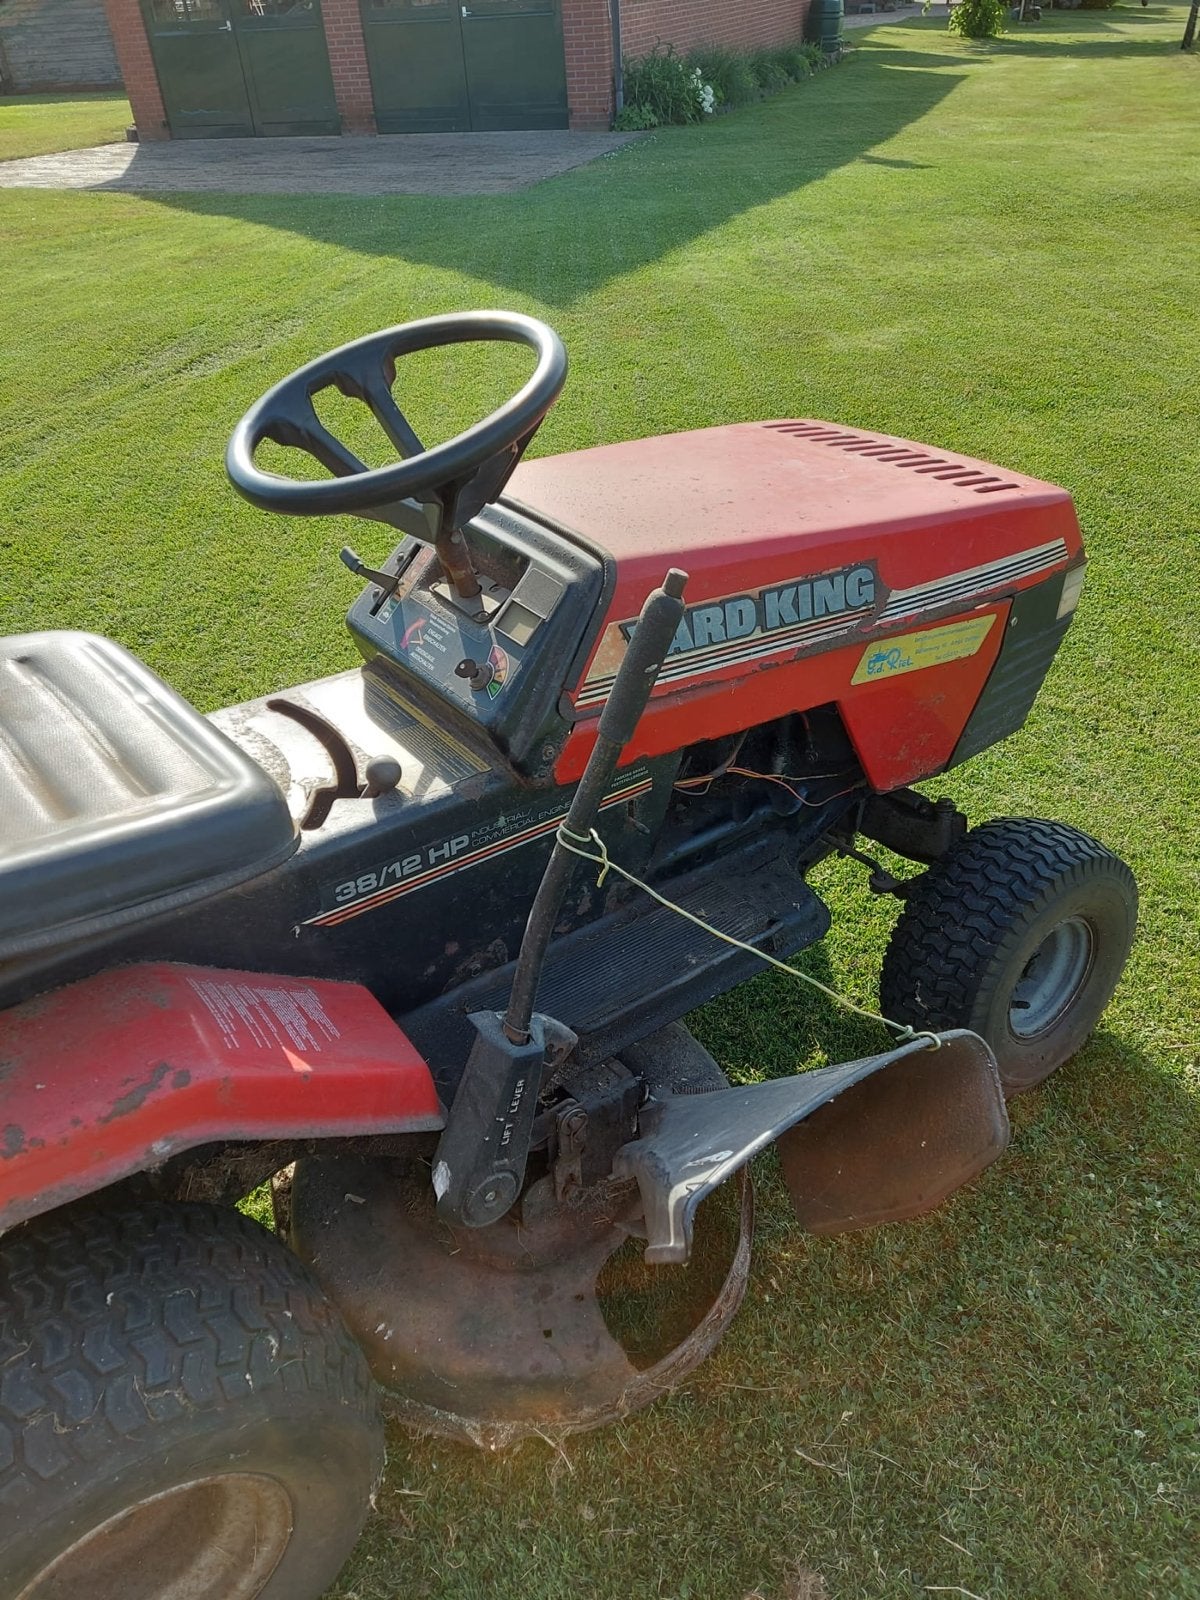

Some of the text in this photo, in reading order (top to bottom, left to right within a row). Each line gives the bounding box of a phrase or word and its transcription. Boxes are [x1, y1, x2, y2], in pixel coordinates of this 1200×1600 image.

[626, 567, 875, 655] ARD KING
[471, 816, 536, 847] COMMERCIAL
[334, 834, 470, 902] 38/12 HP
[501, 1080, 525, 1145] LIFT LEVER
